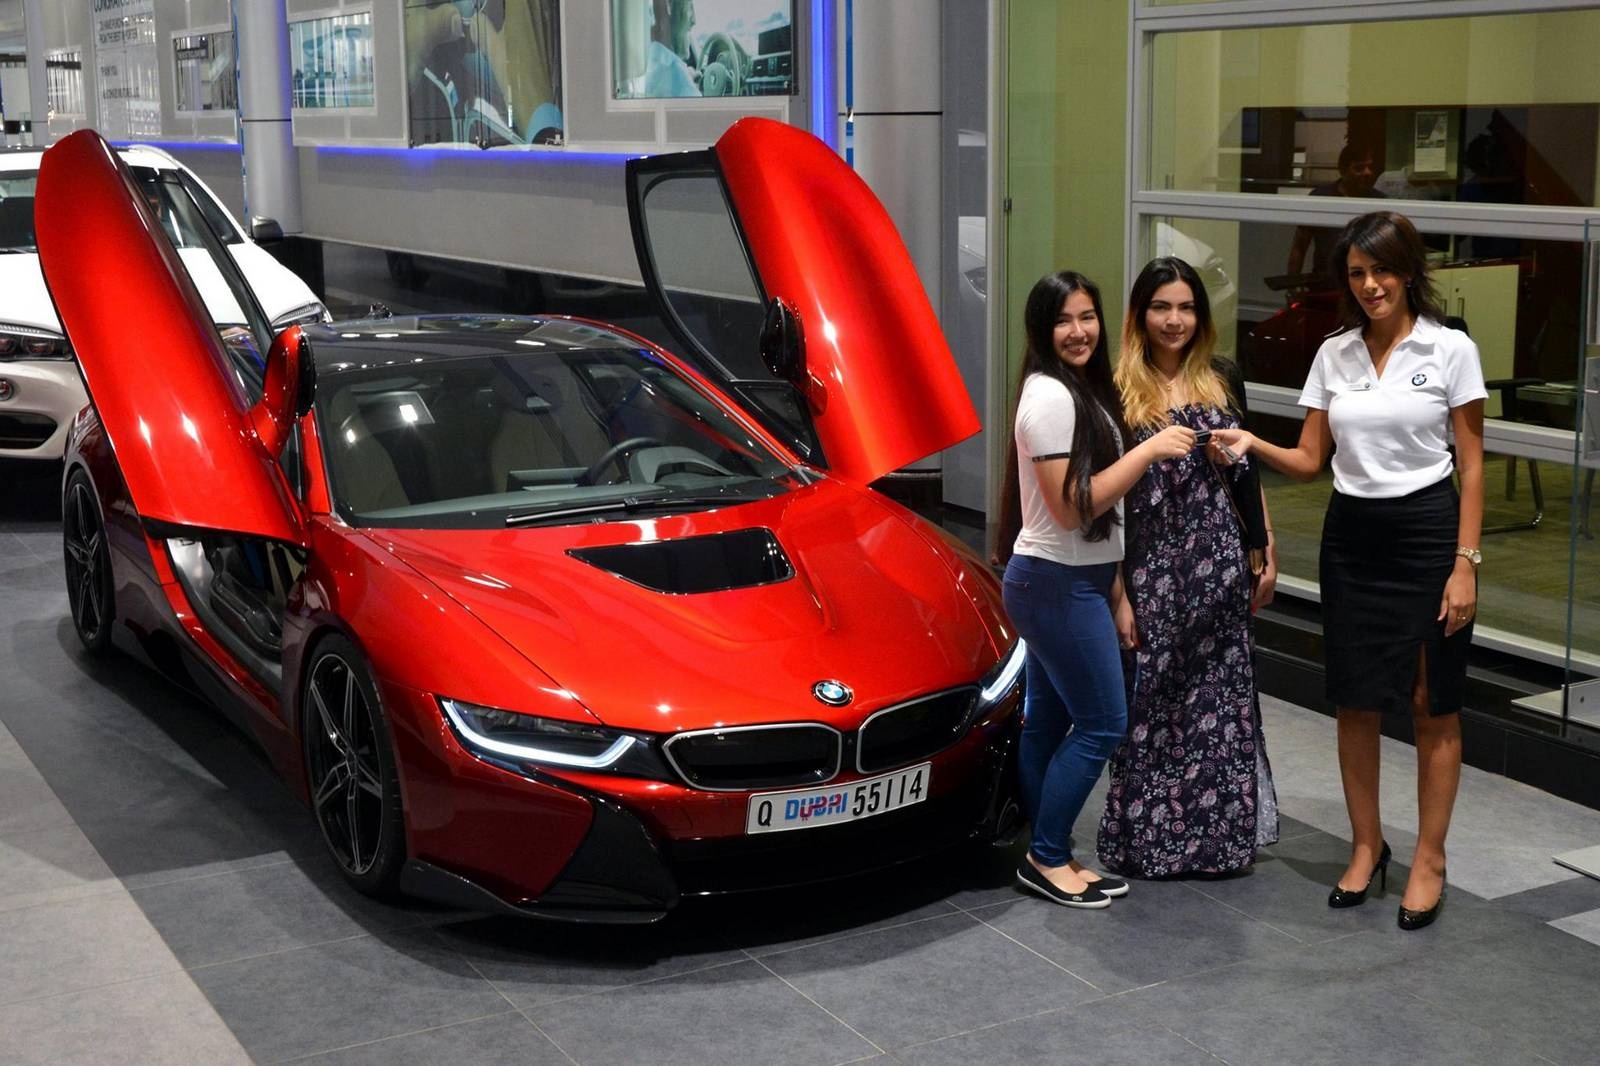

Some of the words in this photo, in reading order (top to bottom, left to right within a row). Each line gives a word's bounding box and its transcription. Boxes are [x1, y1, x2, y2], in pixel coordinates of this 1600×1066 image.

[757, 800, 772, 827] Q
[784, 792, 848, 821] DUBAI
[852, 769, 922, 816] 55114
